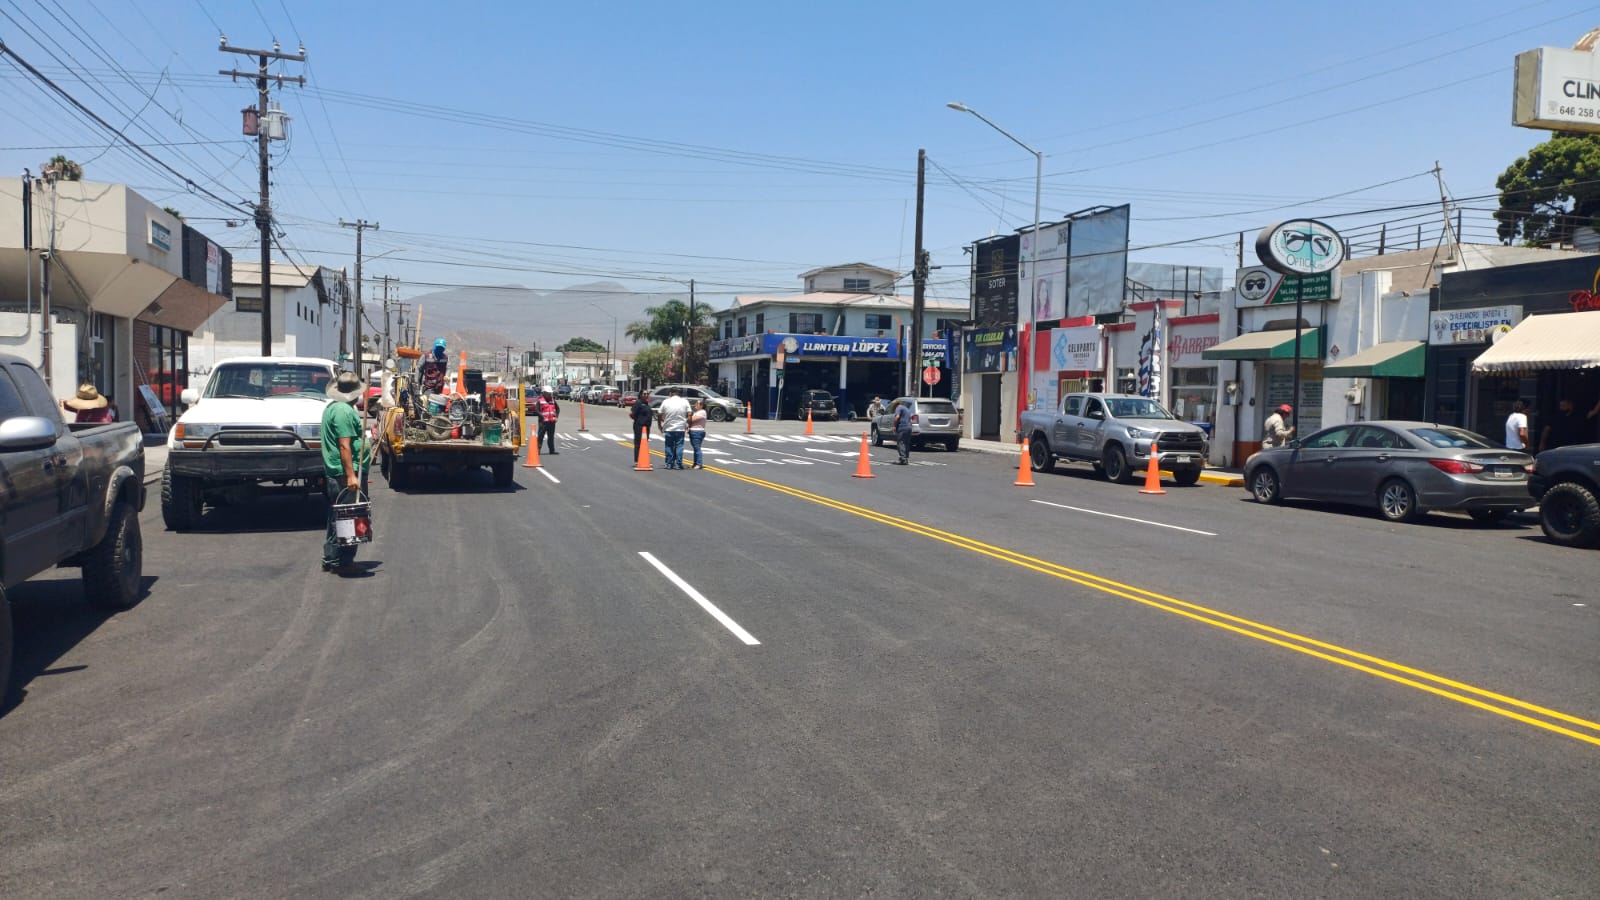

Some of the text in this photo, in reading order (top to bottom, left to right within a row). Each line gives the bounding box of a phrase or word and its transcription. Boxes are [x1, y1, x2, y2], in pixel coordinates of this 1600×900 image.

[1560, 105, 1575, 115] 646
[1578, 107, 1594, 117] 258
[988, 278, 1006, 289] SOTER
[803, 339, 889, 353] LLANTERA LÓPEZ
